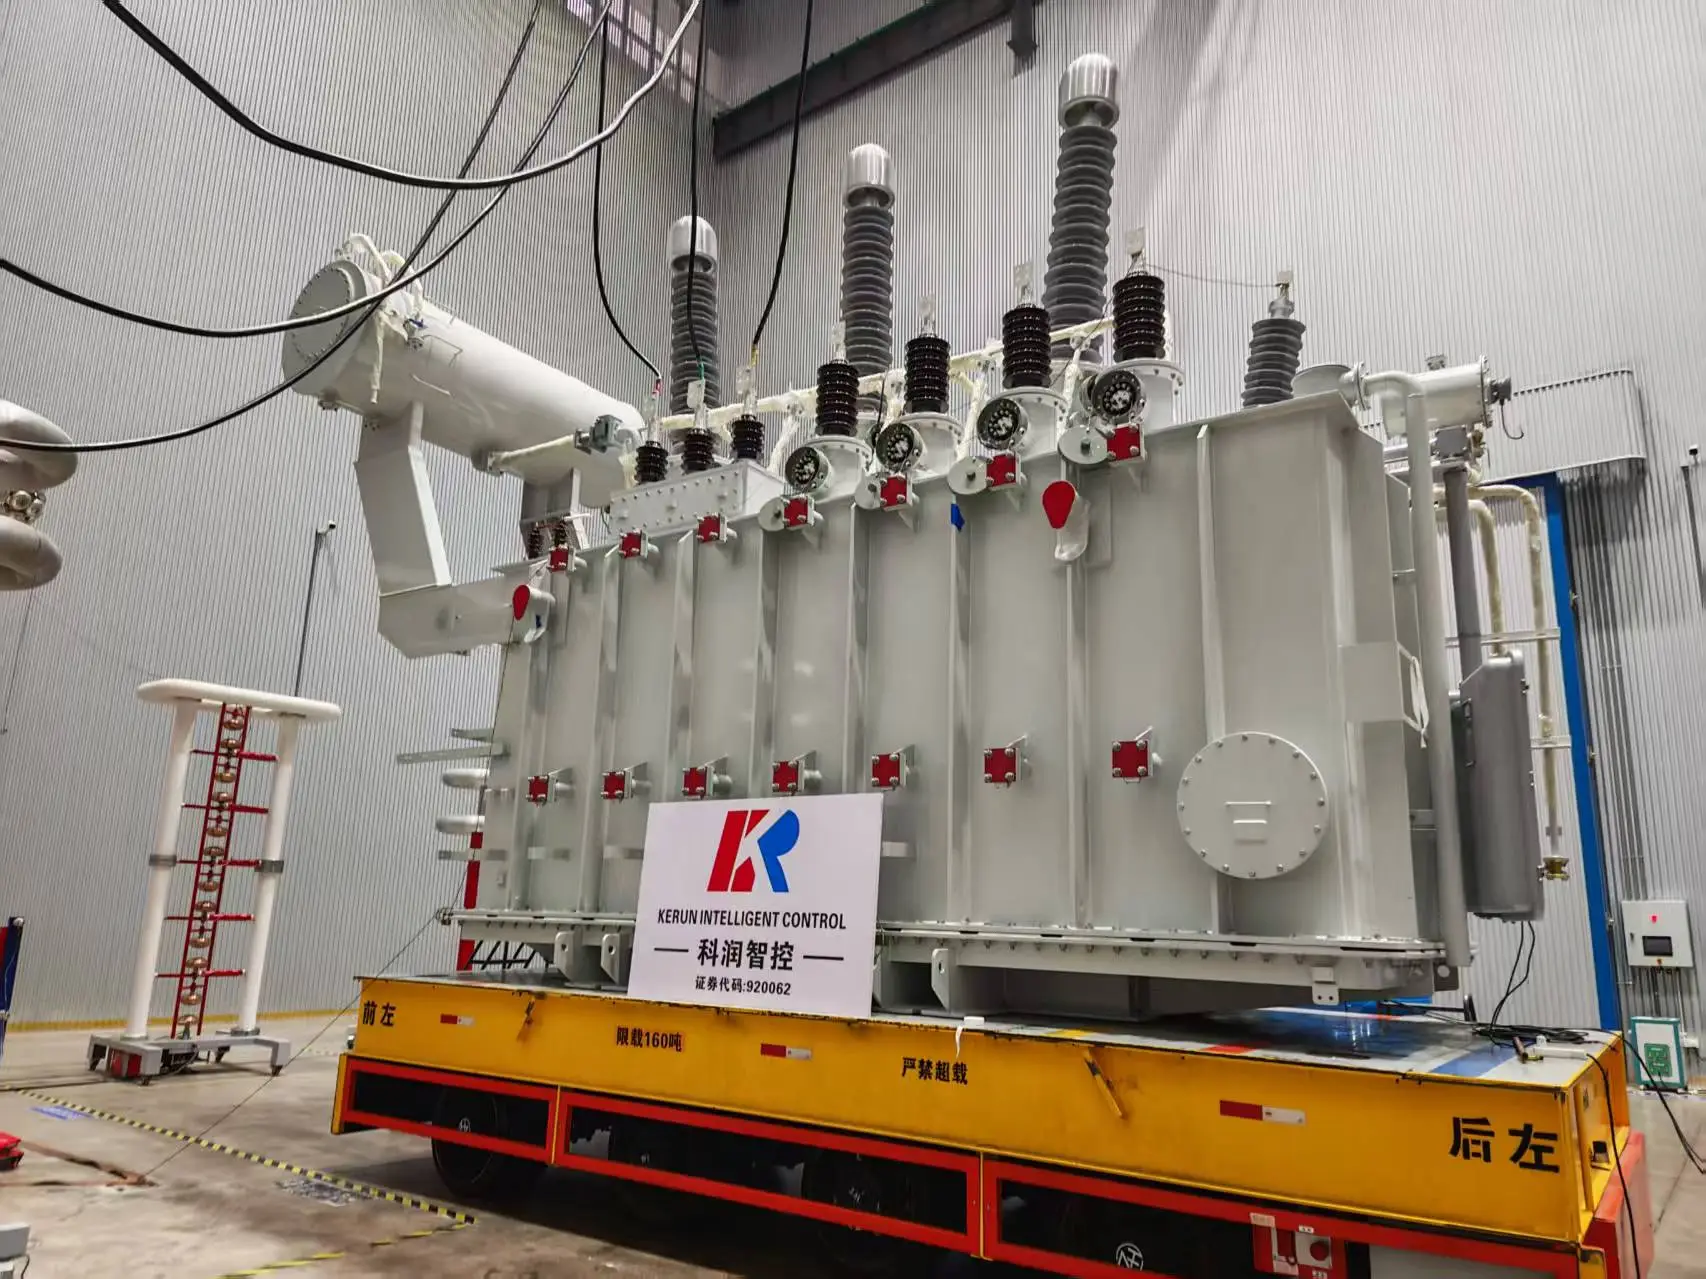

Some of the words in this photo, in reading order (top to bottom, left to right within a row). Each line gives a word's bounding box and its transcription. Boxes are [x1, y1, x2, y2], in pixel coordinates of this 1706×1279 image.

[657, 908, 698, 925] KERUN
[699, 909, 780, 928] INTELLIGENT
[782, 911, 847, 930] CONTROL
[697, 937, 795, 972] 科润智控
[694, 975, 792, 996] 证券代码:920062
[362, 1000, 397, 1027] 前左
[615, 1025, 683, 1053] 限载160吨
[901, 1056, 969, 1086] 严禁超载
[1449, 1116, 1561, 1174] 后左
